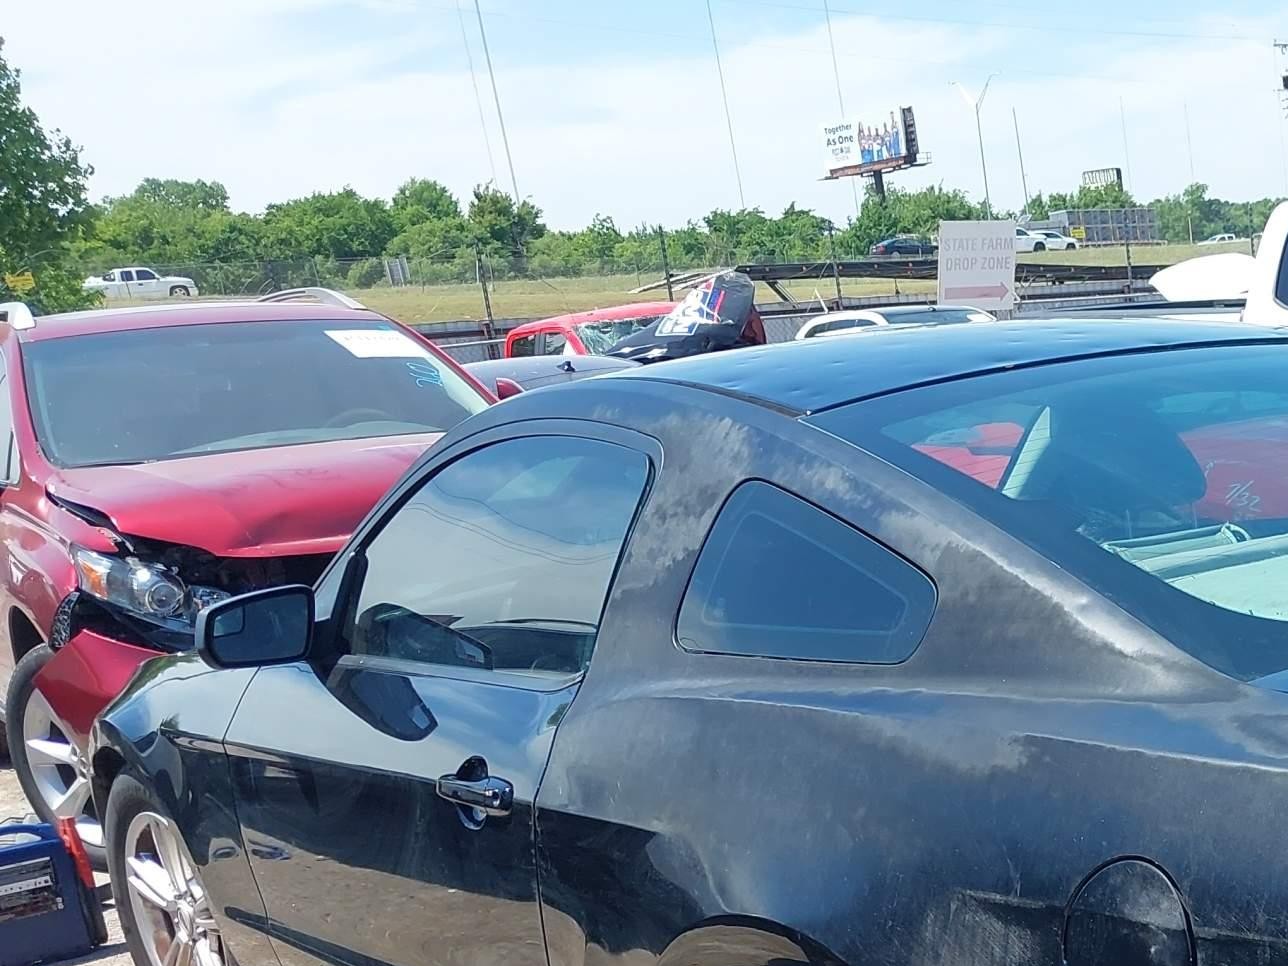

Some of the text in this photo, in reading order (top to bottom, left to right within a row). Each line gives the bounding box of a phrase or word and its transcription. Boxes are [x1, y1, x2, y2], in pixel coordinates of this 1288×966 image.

[824, 124, 852, 135] Together
[826, 135, 854, 147] As One
[944, 237, 1014, 252] STATE FARM
[945, 256, 1012, 271] DROP ZONE
